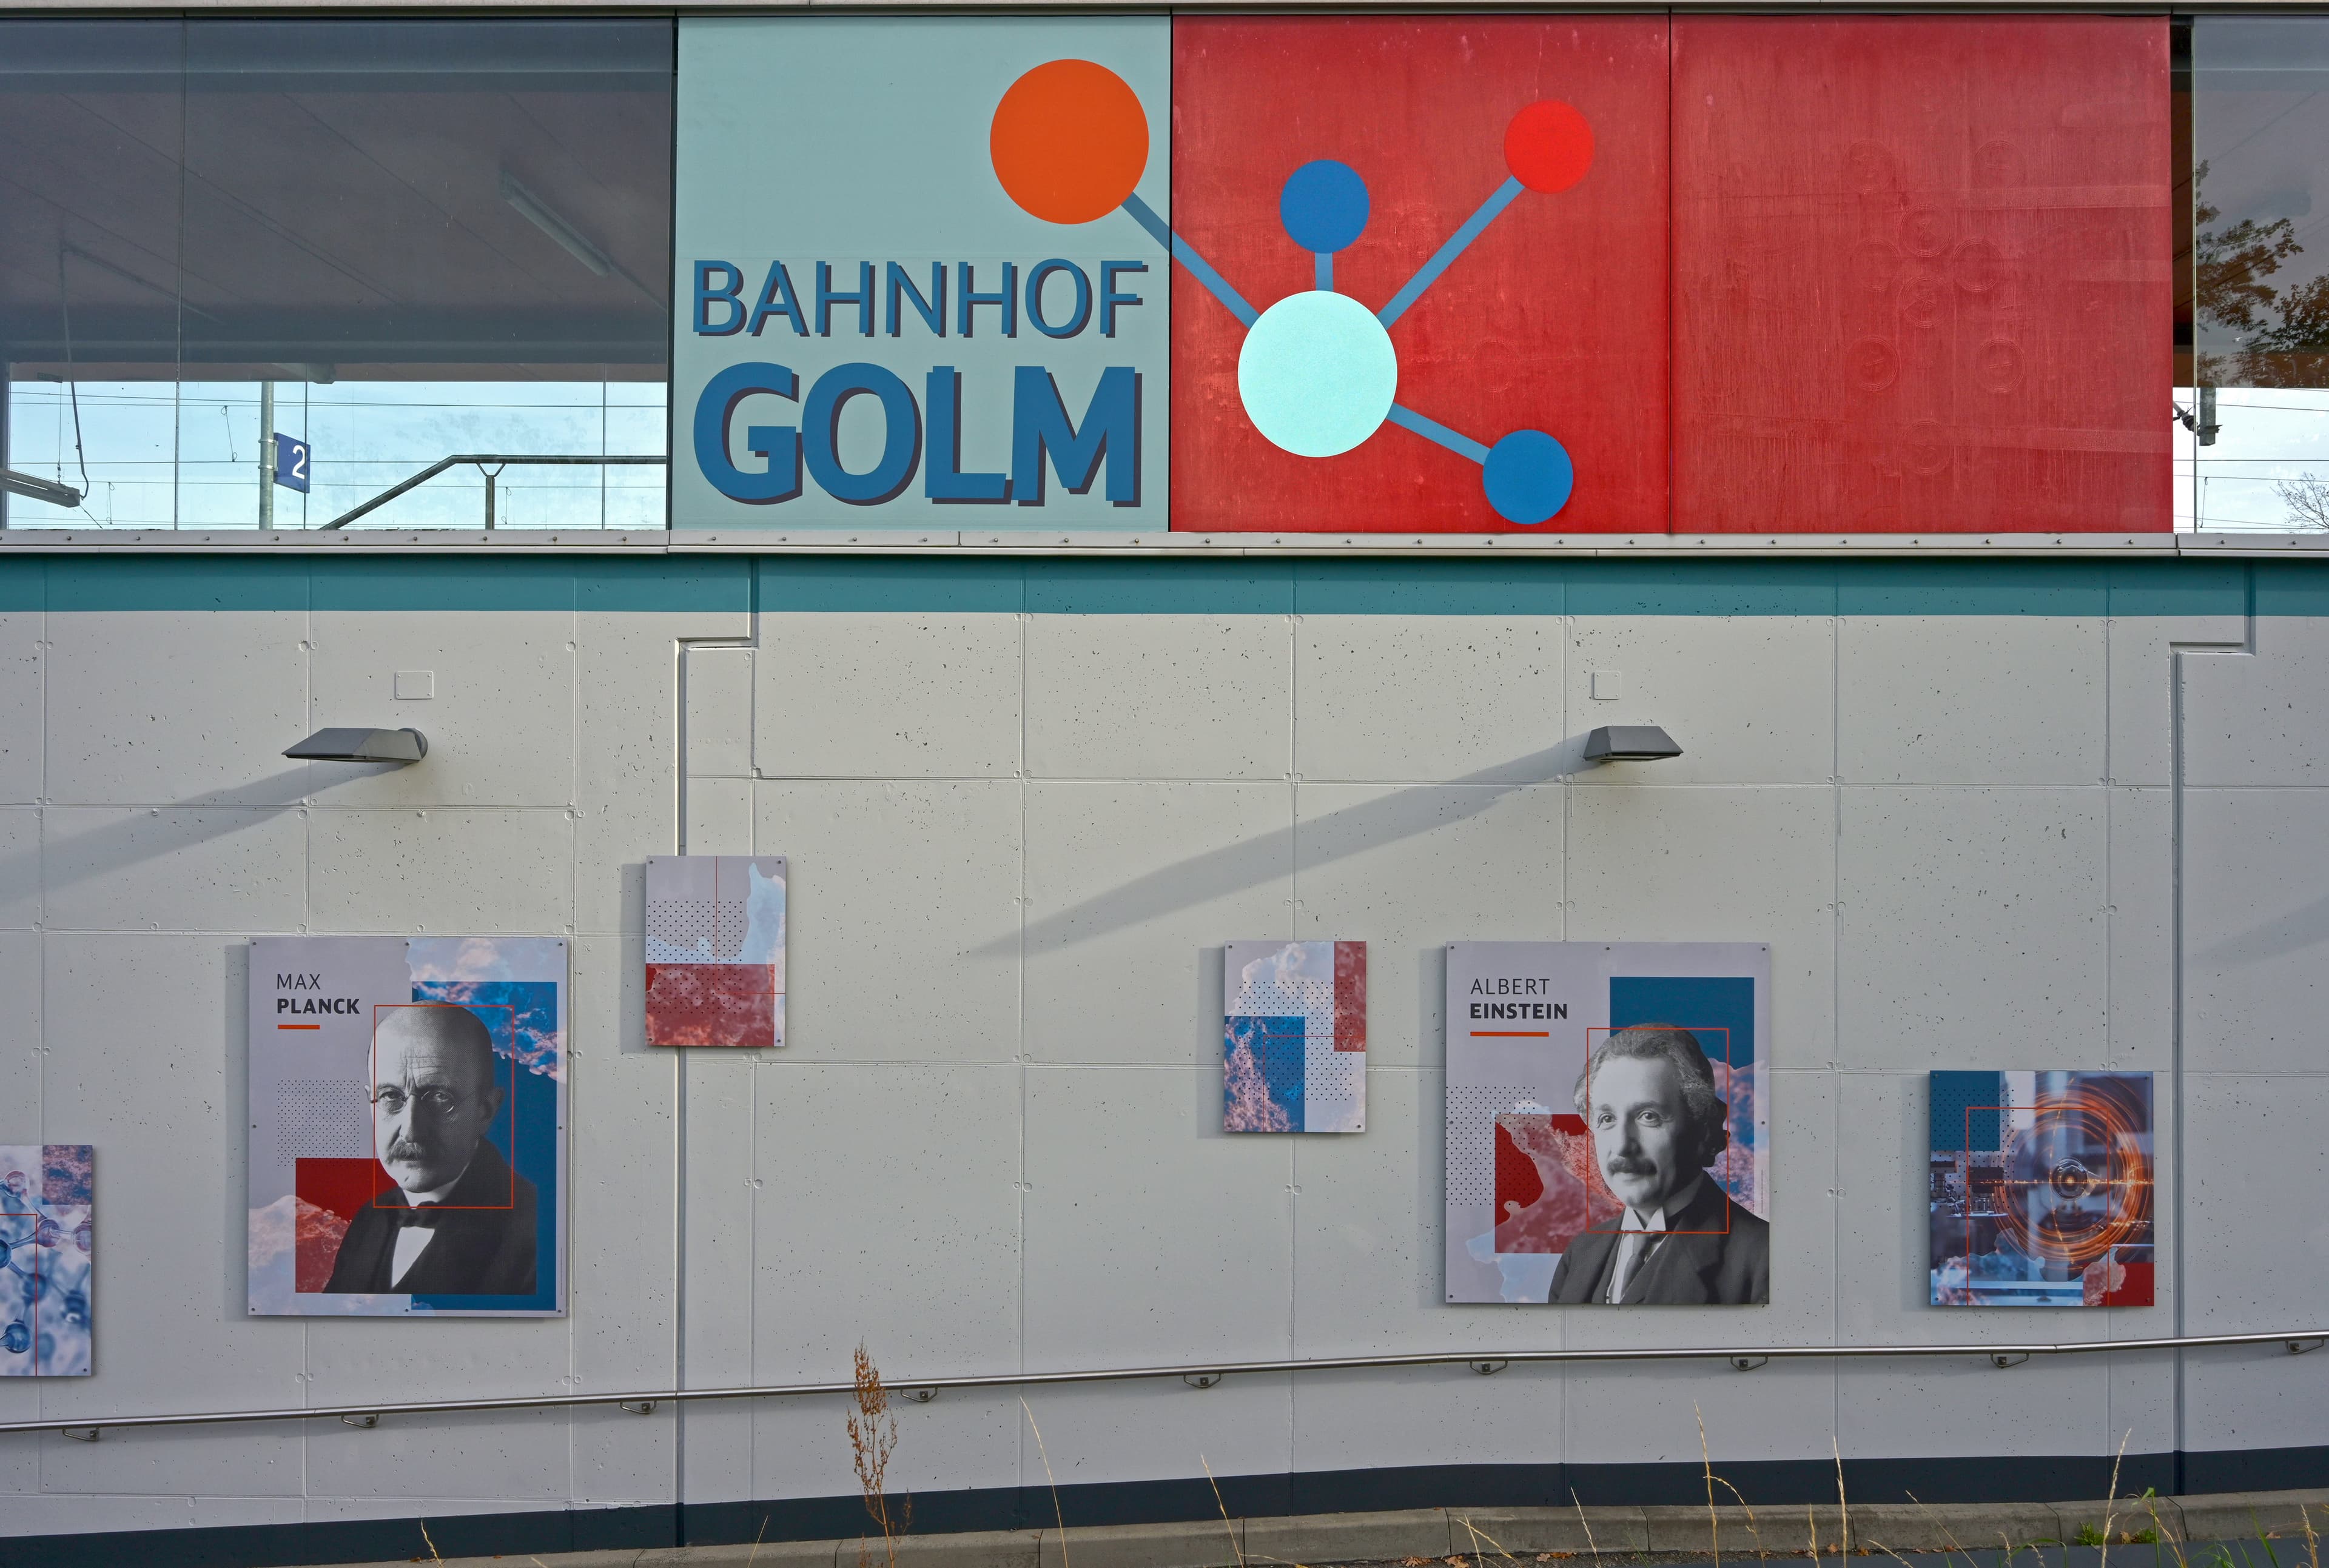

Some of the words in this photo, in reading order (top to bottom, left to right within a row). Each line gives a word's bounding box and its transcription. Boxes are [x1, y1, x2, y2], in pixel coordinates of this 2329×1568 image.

[693, 258, 1148, 339] BAHNHOF
[693, 361, 1143, 508] GOLM
[292, 444, 305, 480] 2
[277, 974, 321, 990] MAX
[1470, 978, 1550, 995] ALBERT
[277, 999, 360, 1014] PLANCK
[1470, 1003, 1567, 1019] EINSTEIN
